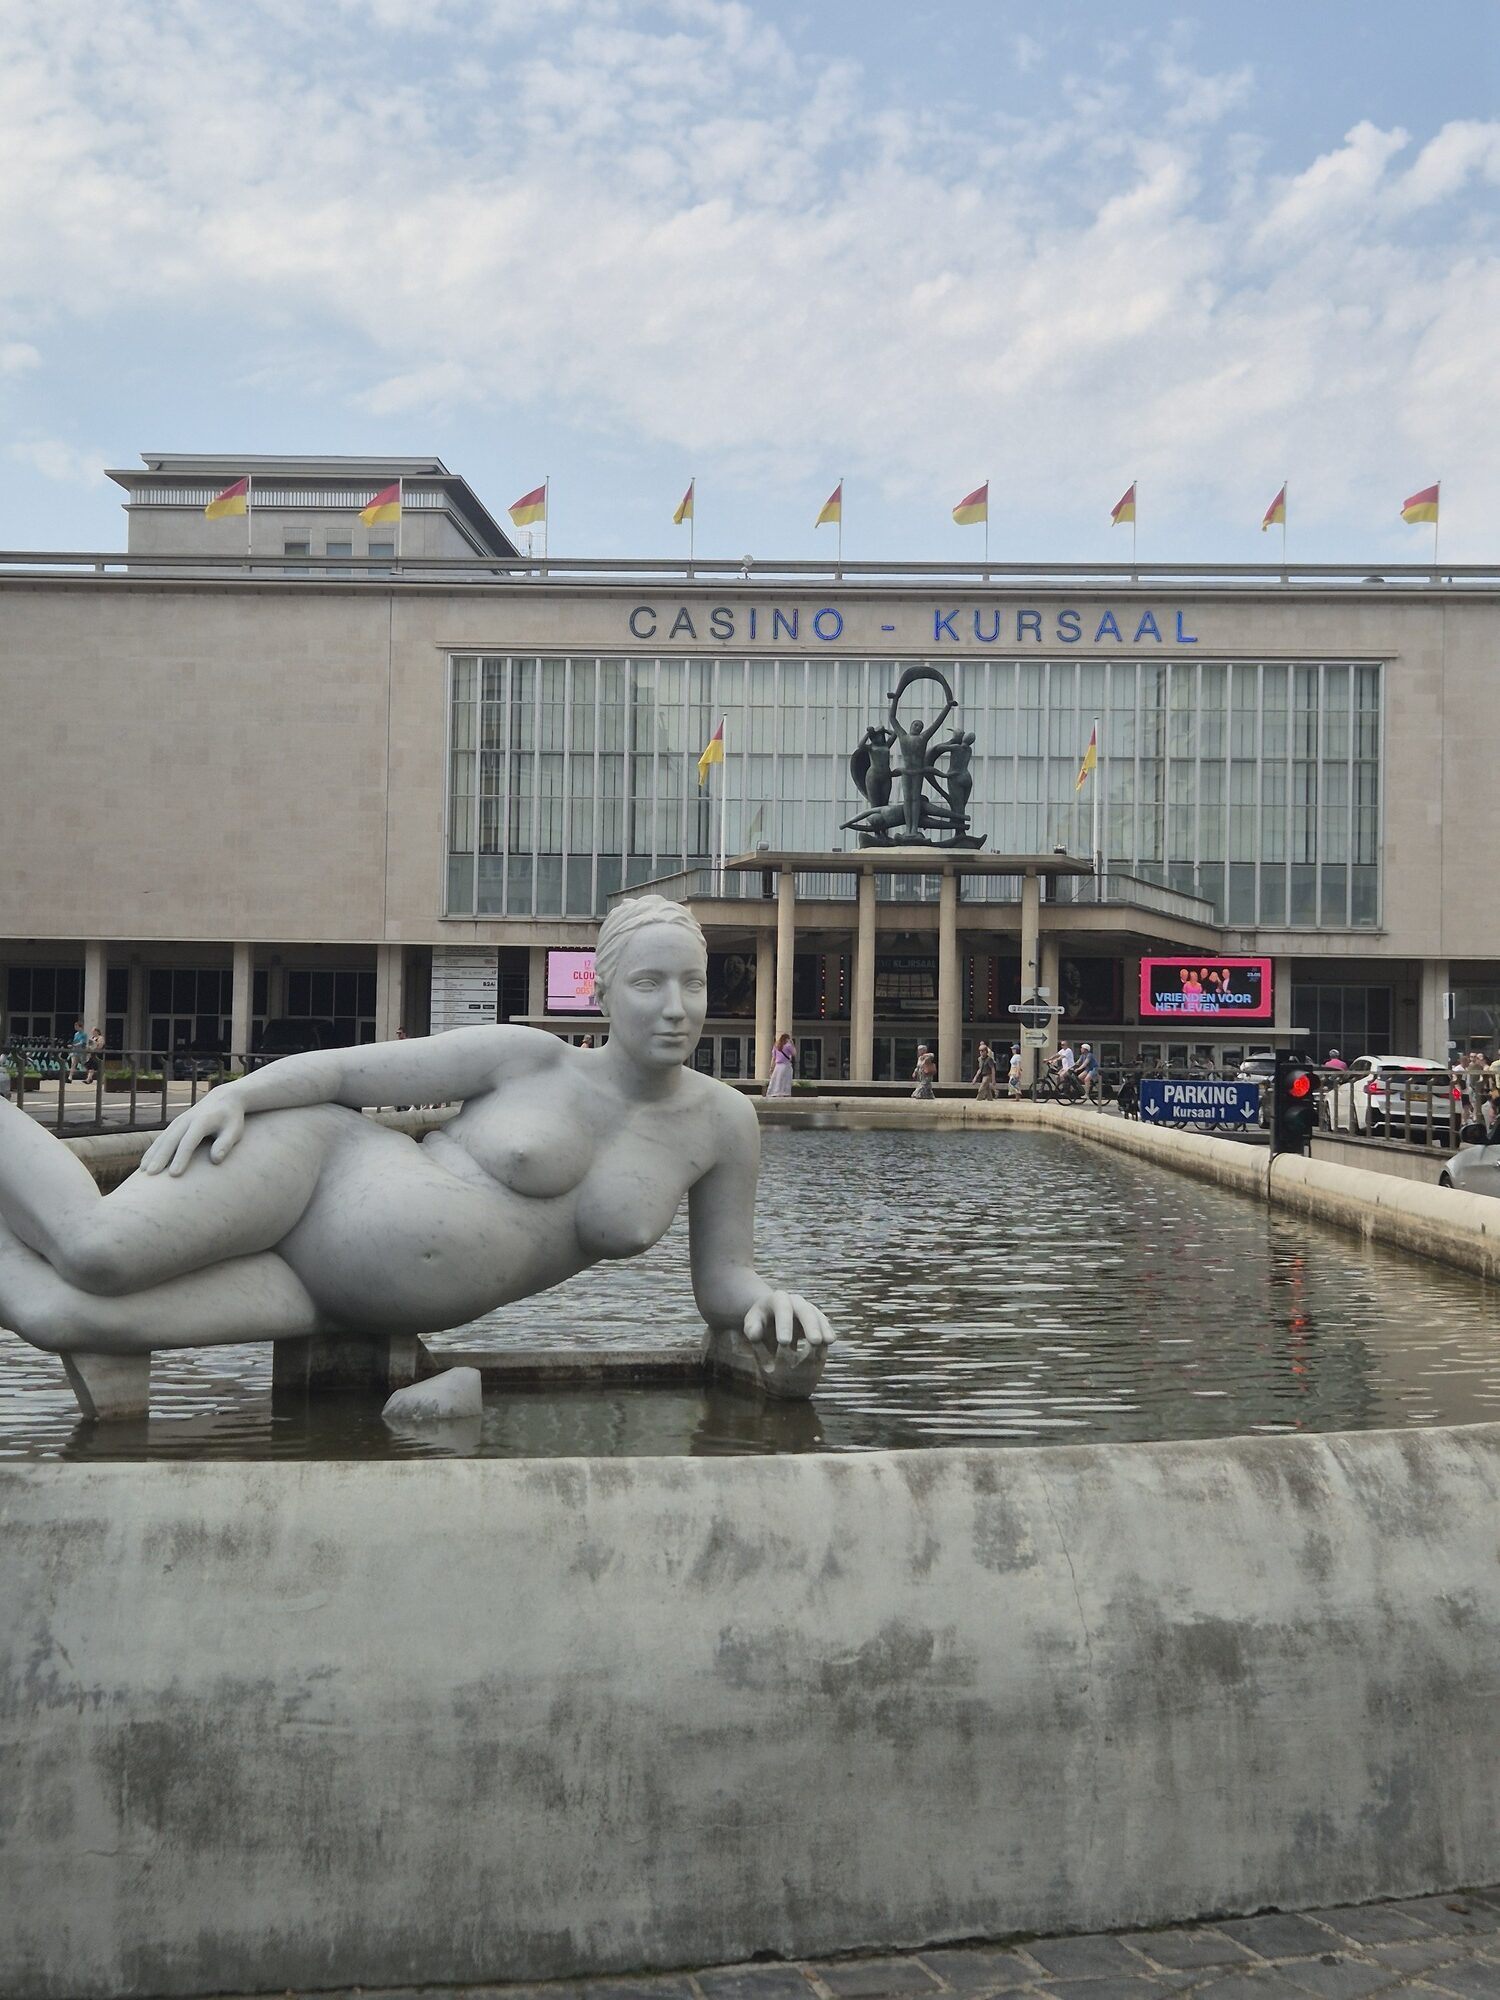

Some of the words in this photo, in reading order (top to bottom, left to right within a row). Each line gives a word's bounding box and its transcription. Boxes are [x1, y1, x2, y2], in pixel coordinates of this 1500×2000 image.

[629, 605, 844, 641] CASINO
[933, 608, 1198, 643] KURSAAL
[1155, 992, 1216, 1003] VRIENDEN
[1218, 993, 1252, 1004] VOOR
[1155, 1002, 1179, 1012] HET
[1181, 1003, 1219, 1013] LEVEN
[1164, 1085, 1238, 1105] PARKING
[1173, 1105, 1215, 1118] Kursaal
[1219, 1107, 1225, 1119] 1
